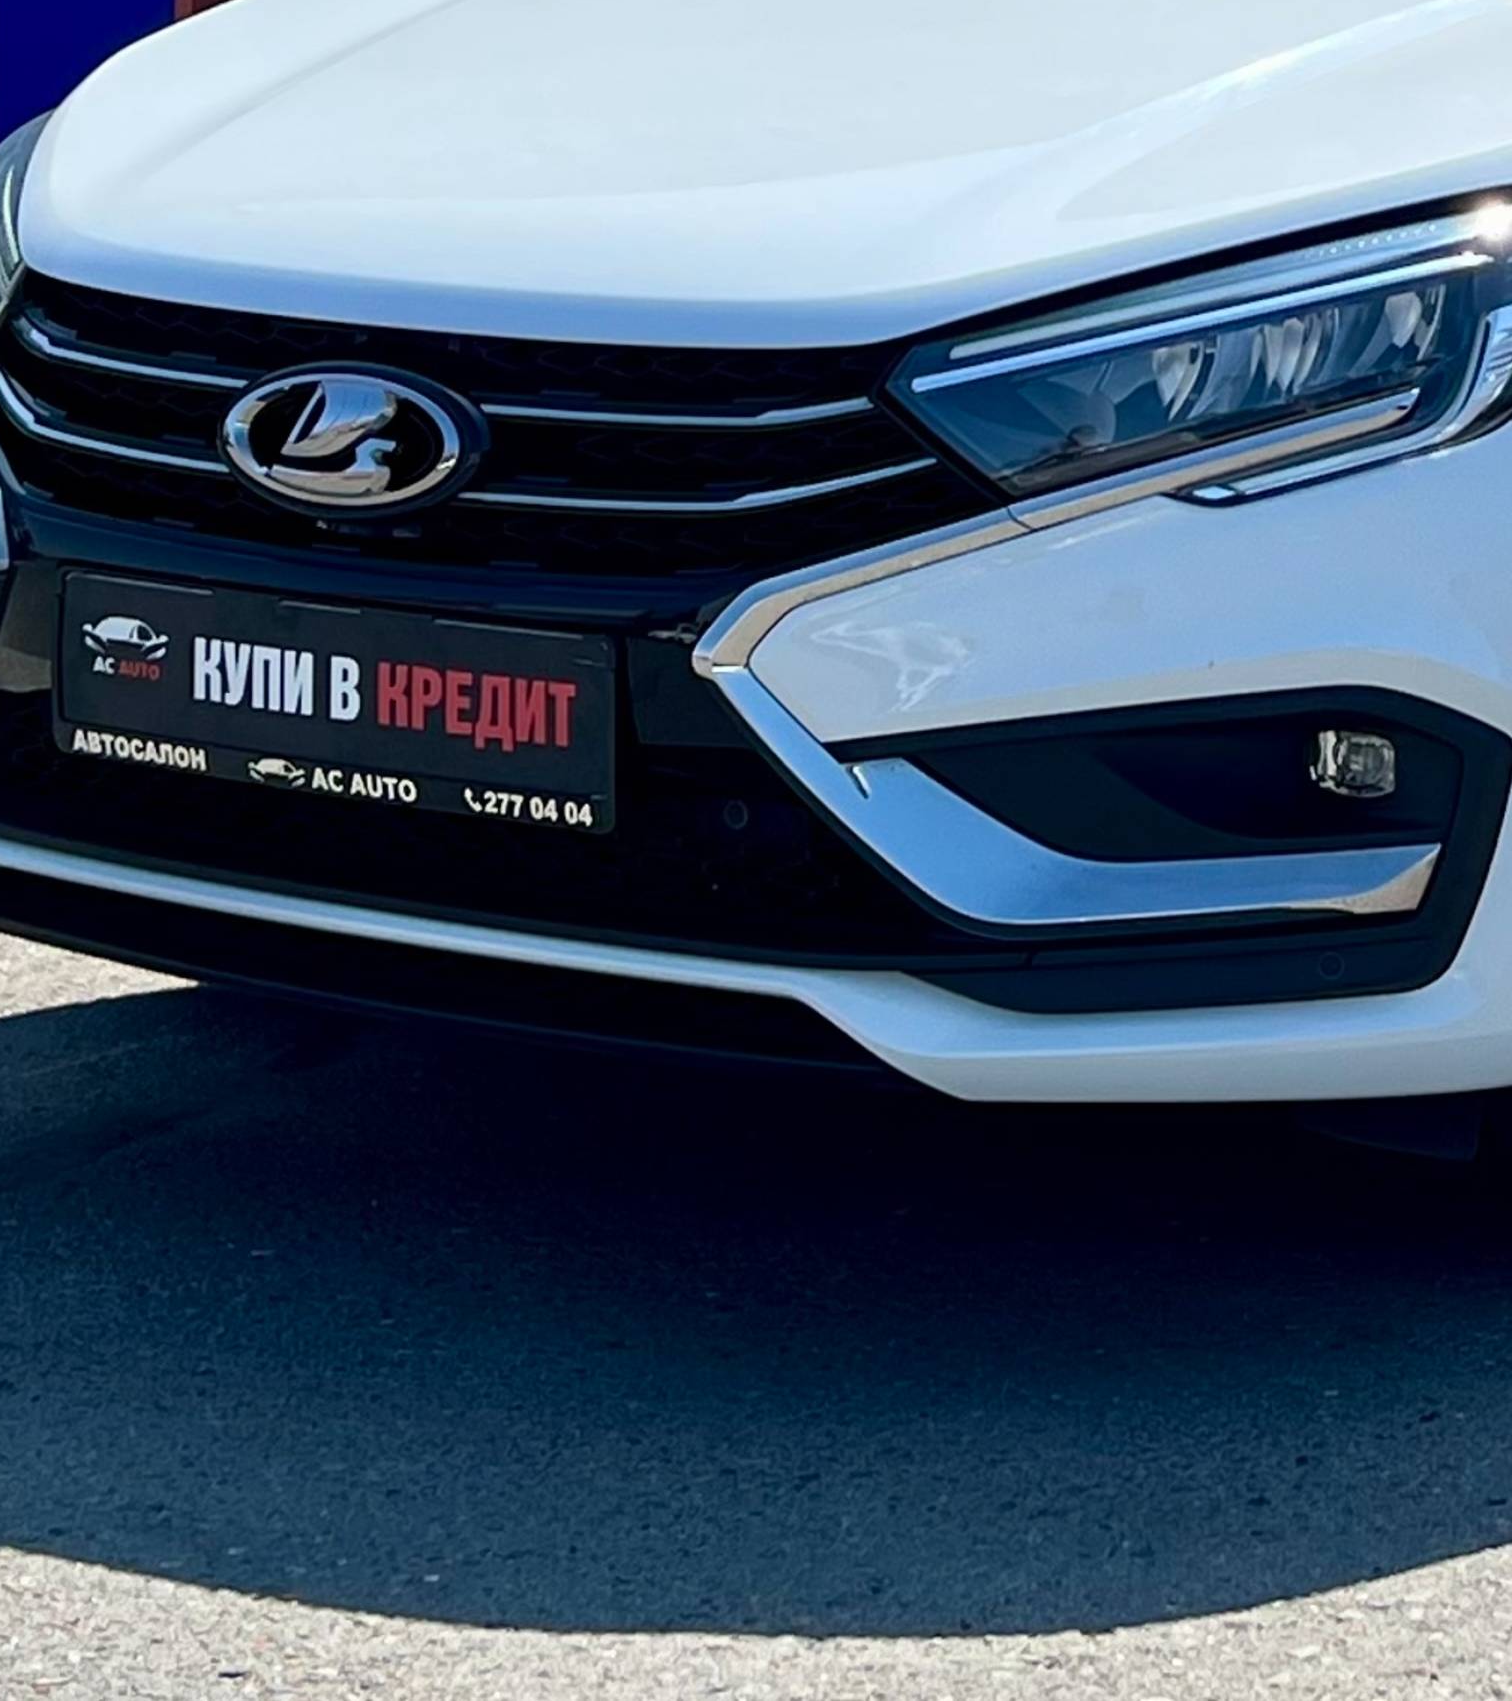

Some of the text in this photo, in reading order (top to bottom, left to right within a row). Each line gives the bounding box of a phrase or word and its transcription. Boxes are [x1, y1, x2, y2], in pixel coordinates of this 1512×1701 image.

[119, 660, 161, 681] AUTO
[192, 636, 577, 752] КУПИ В КРЕДИТ
[72, 728, 207, 772] АВТОСАЛОН
[349, 772, 417, 803] AUTO
[483, 791, 593, 827] 277 04 04
